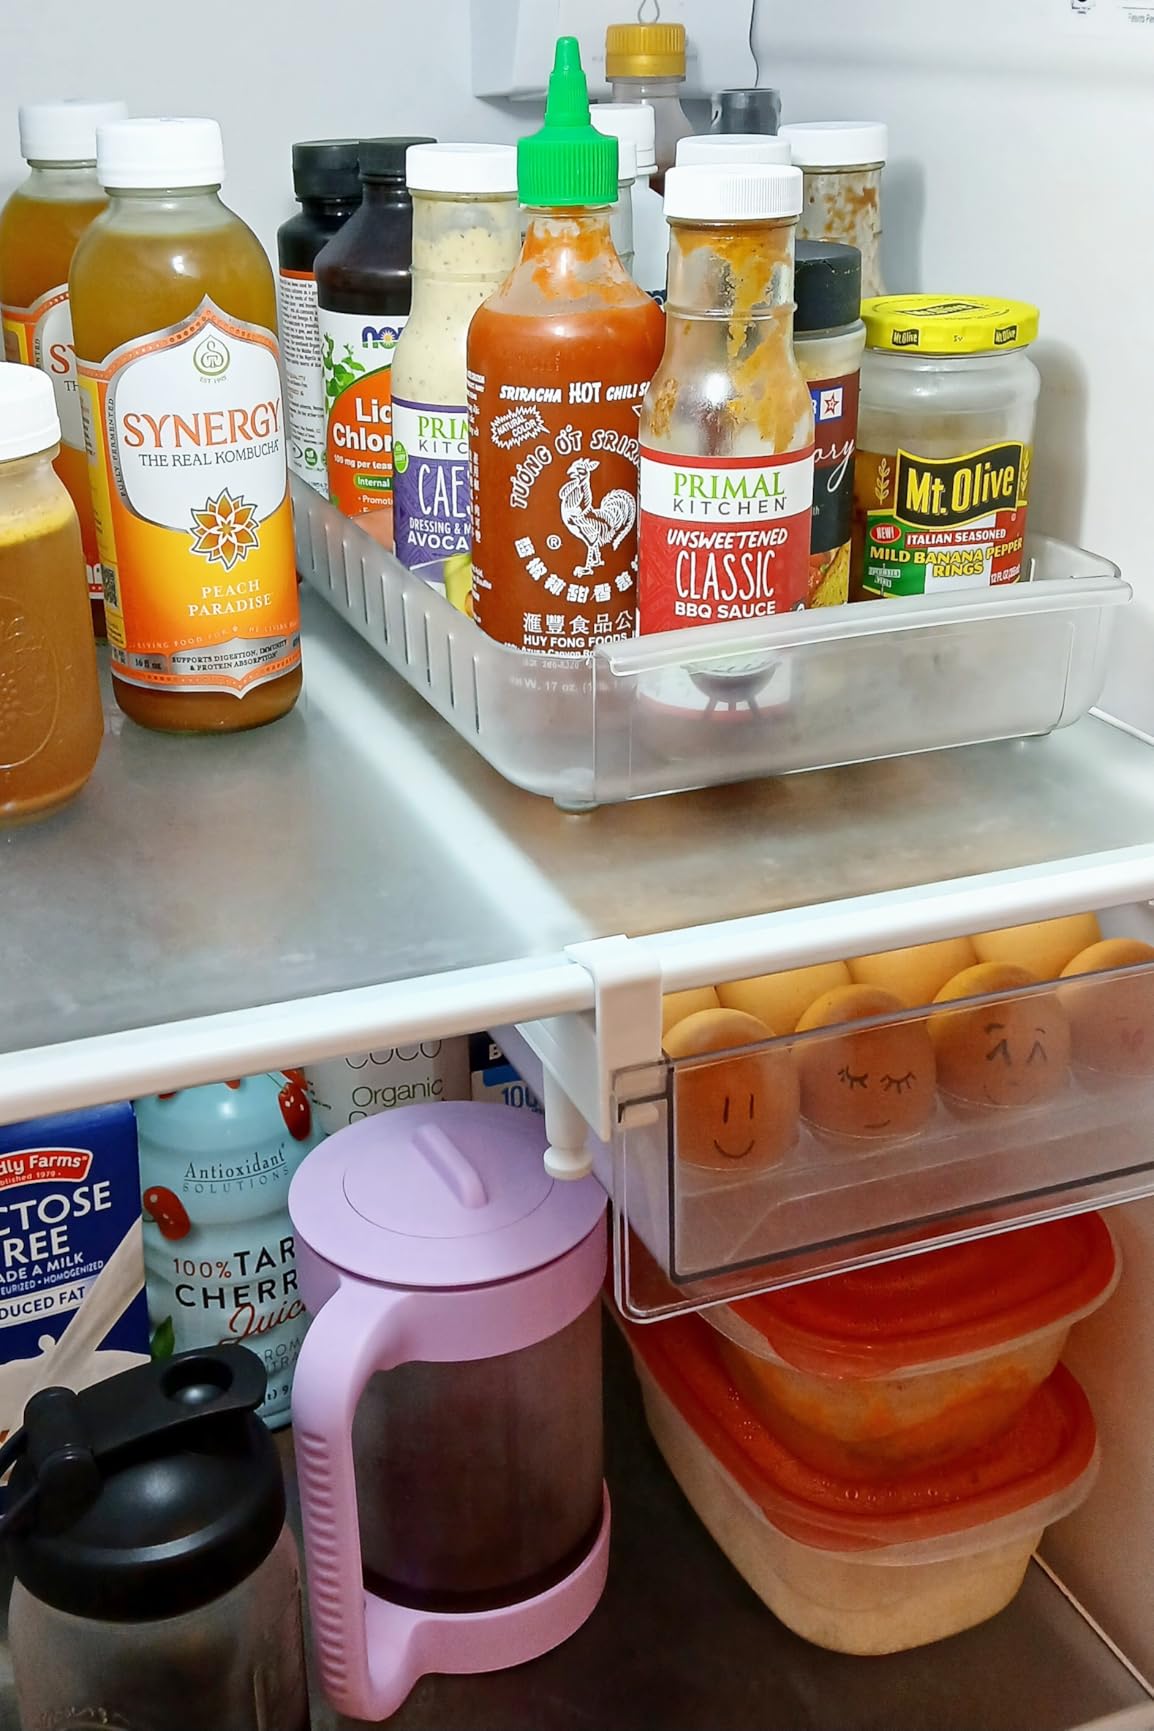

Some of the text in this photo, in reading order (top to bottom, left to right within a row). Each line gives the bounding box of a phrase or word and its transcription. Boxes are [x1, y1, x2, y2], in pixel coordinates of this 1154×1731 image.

[500, 384, 562, 403] SRIRACHA
[569, 382, 602, 404] HOT
[606, 384, 637, 401] CHILI
[108, 398, 118, 461] FERMENTED
[123, 397, 280, 448] SYNERGY
[497, 414, 527, 435] NATURAL
[512, 420, 537, 438] COLOR
[139, 439, 279, 467] THE REAL KOMBUCHA
[344, 457, 356, 470] mg
[357, 459, 370, 470] per
[115, 464, 126, 496] FULLY
[357, 476, 391, 488] Internal
[418, 463, 470, 518] CAE
[673, 472, 785, 499] PRIMAL
[906, 462, 1015, 516] Mt. Olive
[673, 498, 786, 516] KITCHEN
[409, 517, 451, 535] DRESSING
[454, 523, 461, 535] &
[876, 526, 895, 540] NEW!
[667, 528, 788, 549] UNSWEETENED
[907, 529, 1006, 545] ITALIAN SEASONED
[870, 538, 1023, 565] MILD BANANA PEPPER
[675, 550, 775, 601] CLASSIC
[932, 562, 983, 577] RINGS
[201, 579, 260, 599] PEACH
[188, 593, 272, 617] PARADISE
[675, 601, 712, 618] BBQ
[718, 601, 776, 619] SAUCE
[174, 636, 203, 647] FOOD
[523, 635, 548, 646] HUY
[550, 637, 585, 648] FONG
[588, 633, 627, 647] FOODS
[172, 655, 212, 664] SUPPORTS
[213, 650, 259, 662] DIGESTION,
[259, 639, 288, 654] IMMUNITY
[197, 662, 232, 671] PROTEIN
[352, 1077, 444, 1107] Organic
[30, 1154, 82, 1169] Farms
[184, 1152, 286, 1179] Antioxidant
[36, 1170, 56, 1179] 1979
[183, 1167, 289, 1194] SOLUTIONS
[32, 1264, 43, 1277] A
[47, 1251, 84, 1272] MILK
[43, 1259, 104, 1285] HOMOGENIZED
[173, 1258, 232, 1279] 100%
[59, 1286, 86, 1304] FAT
